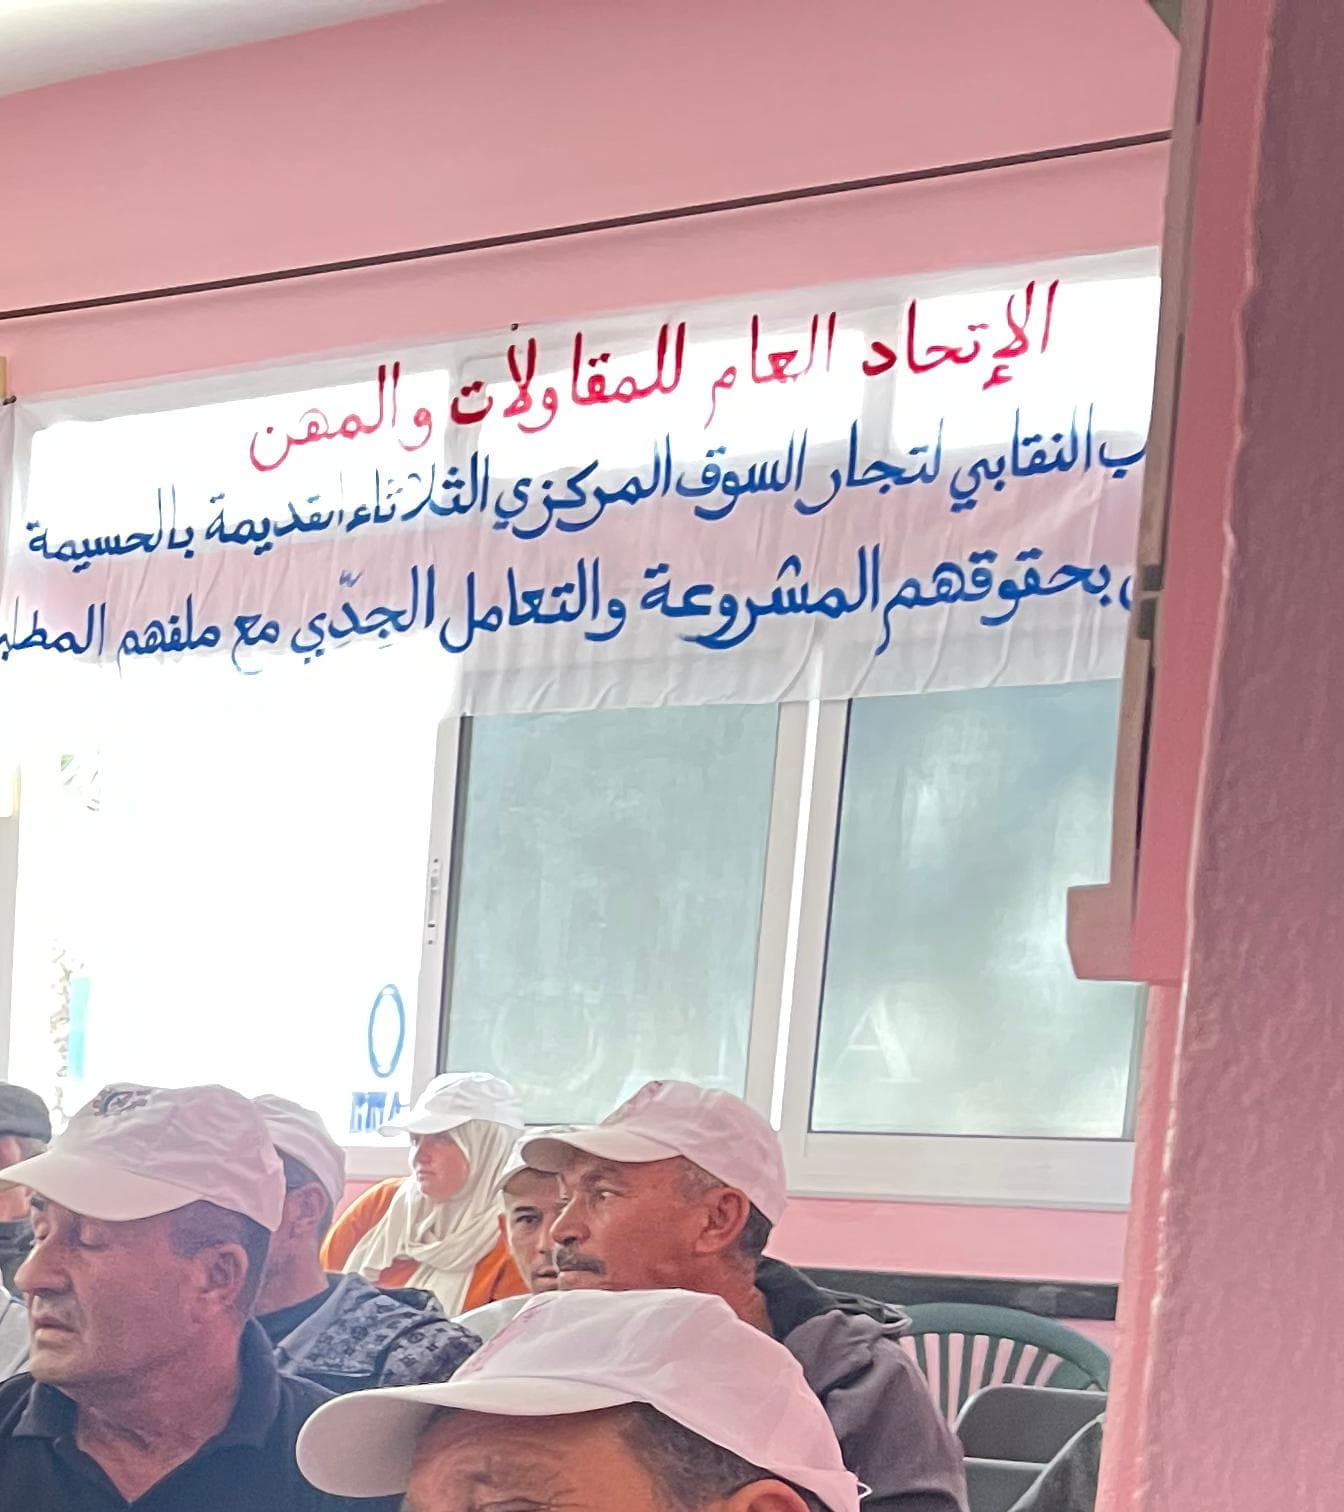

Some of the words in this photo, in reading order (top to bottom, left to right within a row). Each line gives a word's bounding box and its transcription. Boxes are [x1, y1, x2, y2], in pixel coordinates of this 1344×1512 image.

[449, 320, 687, 434] للمقاولات
[703, 311, 837, 431] العام
[861, 279, 1060, 391] الإتحاد
[248, 360, 433, 472] والمهن
[793, 415, 944, 516] لتجار
[949, 400, 1094, 513] النقابي
[25, 482, 195, 573] بالحسيمة
[493, 431, 673, 541] المركزي
[674, 427, 808, 521] السوق
[116, 592, 223, 681] ملفهم
[229, 612, 282, 676] مع
[439, 555, 627, 654] والتعامل
[639, 542, 881, 650] المشروعة
[874, 547, 1113, 657] بحقوقهم
